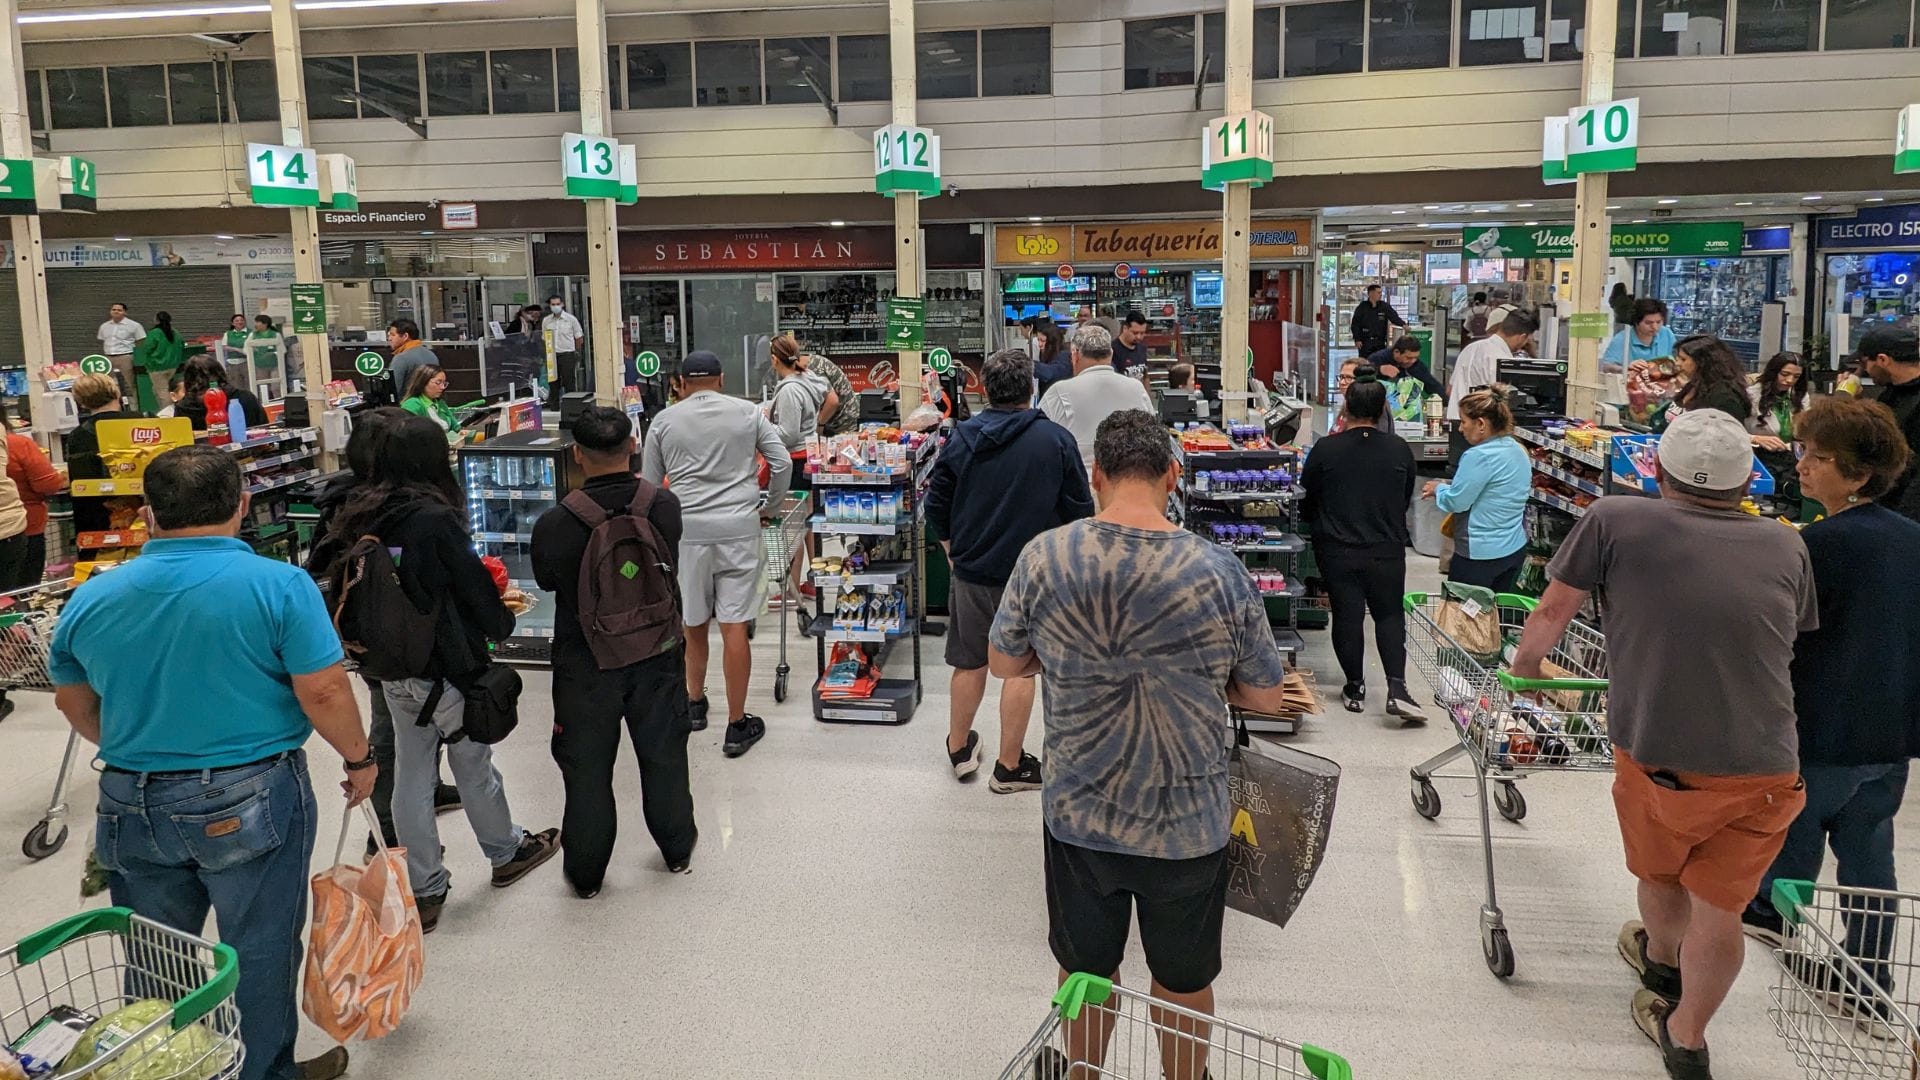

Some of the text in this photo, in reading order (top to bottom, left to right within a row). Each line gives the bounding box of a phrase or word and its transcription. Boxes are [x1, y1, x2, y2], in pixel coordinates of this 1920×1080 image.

[1259, 117, 1270, 156] 11
[1577, 105, 1629, 146] 10
[1217, 117, 1247, 157] 11
[572, 139, 613, 175] 13
[876, 131, 890, 169] 12
[896, 130, 929, 167] 12
[80, 162, 90, 191] 2
[256, 149, 309, 185] 14
[325, 212, 426, 223] Espacio Financiero
[1249, 230, 1298, 245] OTERIA
[1531, 229, 1670, 246] Vuel RONTO
[1831, 222, 1893, 238] ELECTRO
[655, 239, 853, 261] SEBASTIÁN
[1015, 234, 1059, 256] Loto
[1084, 227, 1219, 258] Tabaquería
[91, 250, 143, 261] MEDICAL
[86, 360, 107, 373] 13
[361, 357, 379, 370] 12
[641, 357, 654, 371] 11
[933, 354, 948, 367] 10
[1303, 793, 1327, 871] SODIMAC.COM
